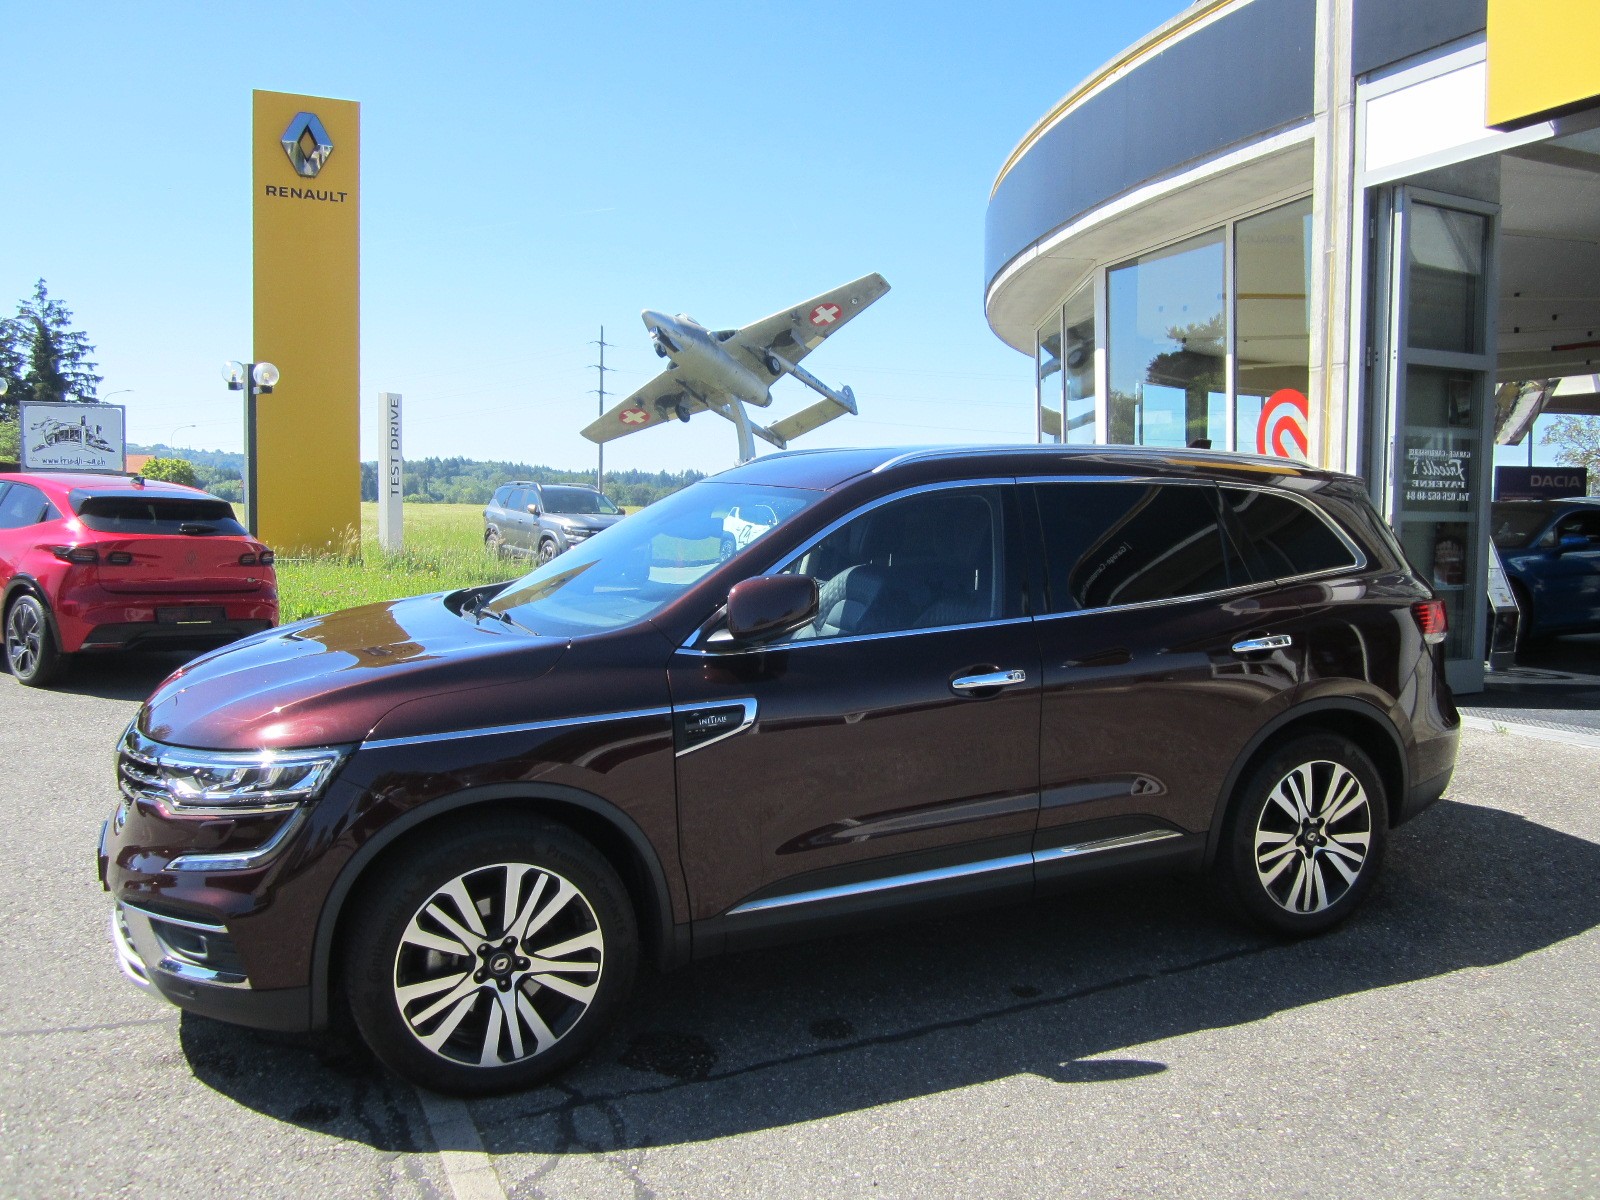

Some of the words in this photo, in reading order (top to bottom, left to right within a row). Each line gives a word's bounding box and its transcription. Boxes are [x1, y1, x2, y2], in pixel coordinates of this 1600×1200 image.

[265, 185, 347, 202] RENAULT
[390, 398, 400, 450] DRIVE
[390, 455, 400, 497] TEST
[1530, 475, 1581, 488] DACIA
